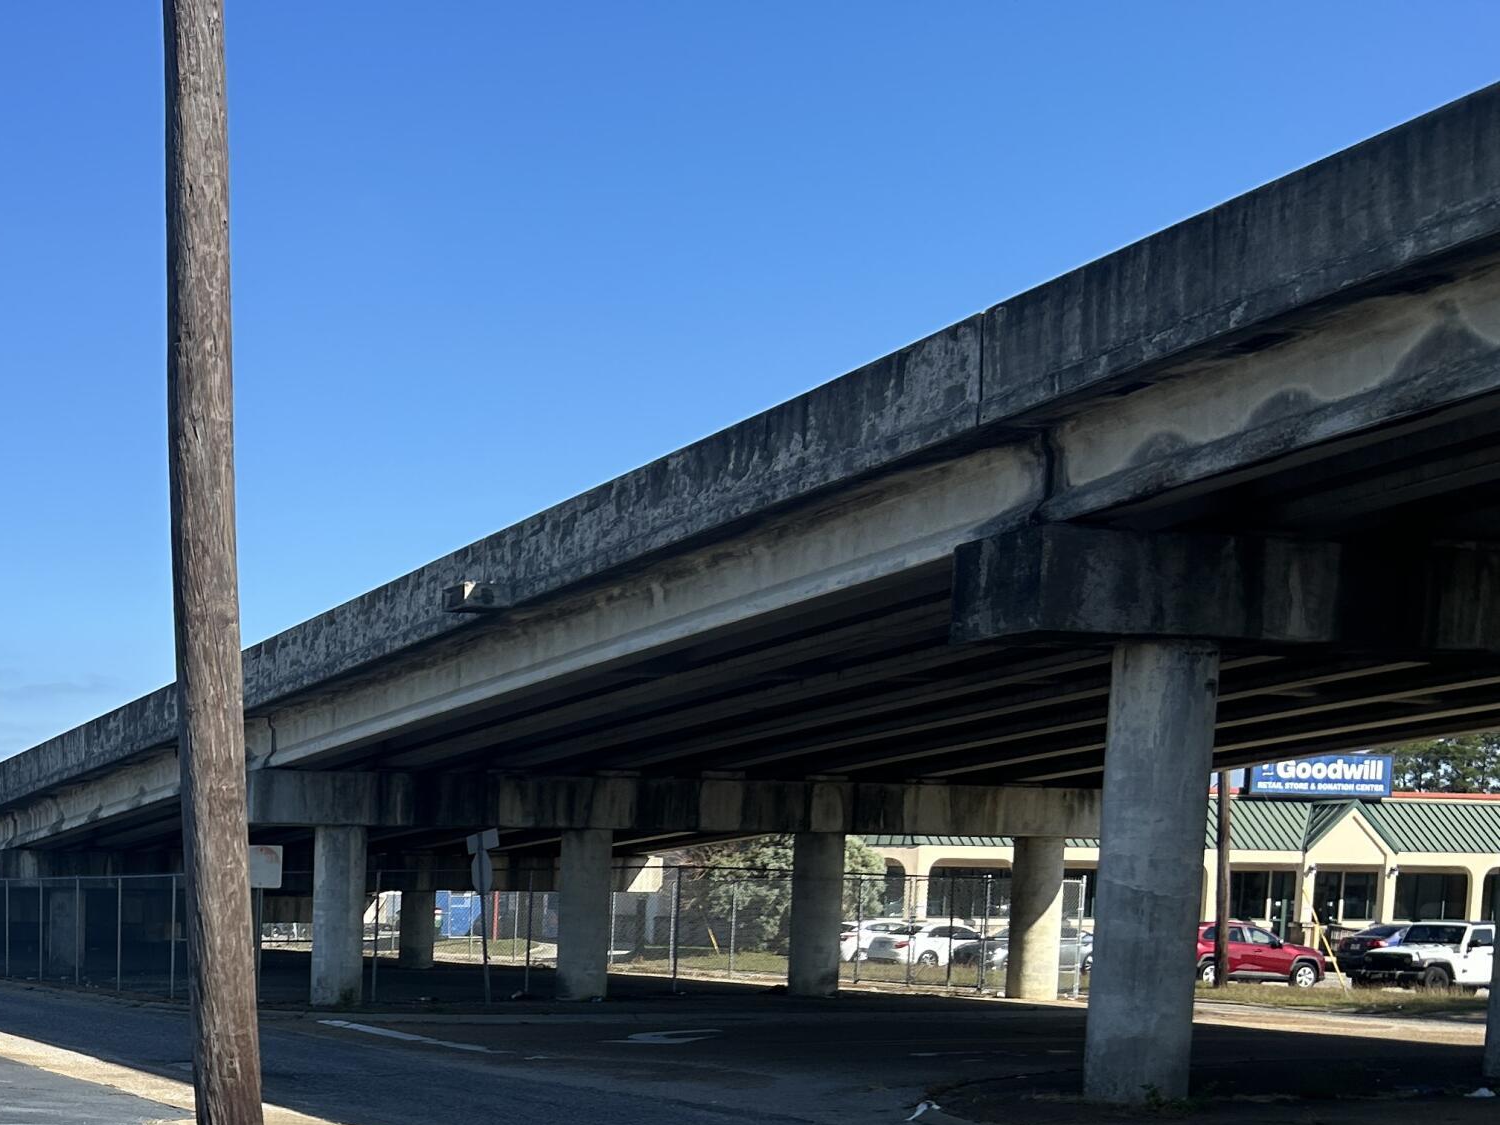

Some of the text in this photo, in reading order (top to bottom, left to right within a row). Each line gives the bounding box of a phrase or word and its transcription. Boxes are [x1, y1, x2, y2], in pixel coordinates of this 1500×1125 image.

[1276, 759, 1384, 780] Goodwill
[1284, 782, 1308, 790] STORE
[1317, 783, 1354, 791] DONATION
[1355, 784, 1384, 792] CENTER
